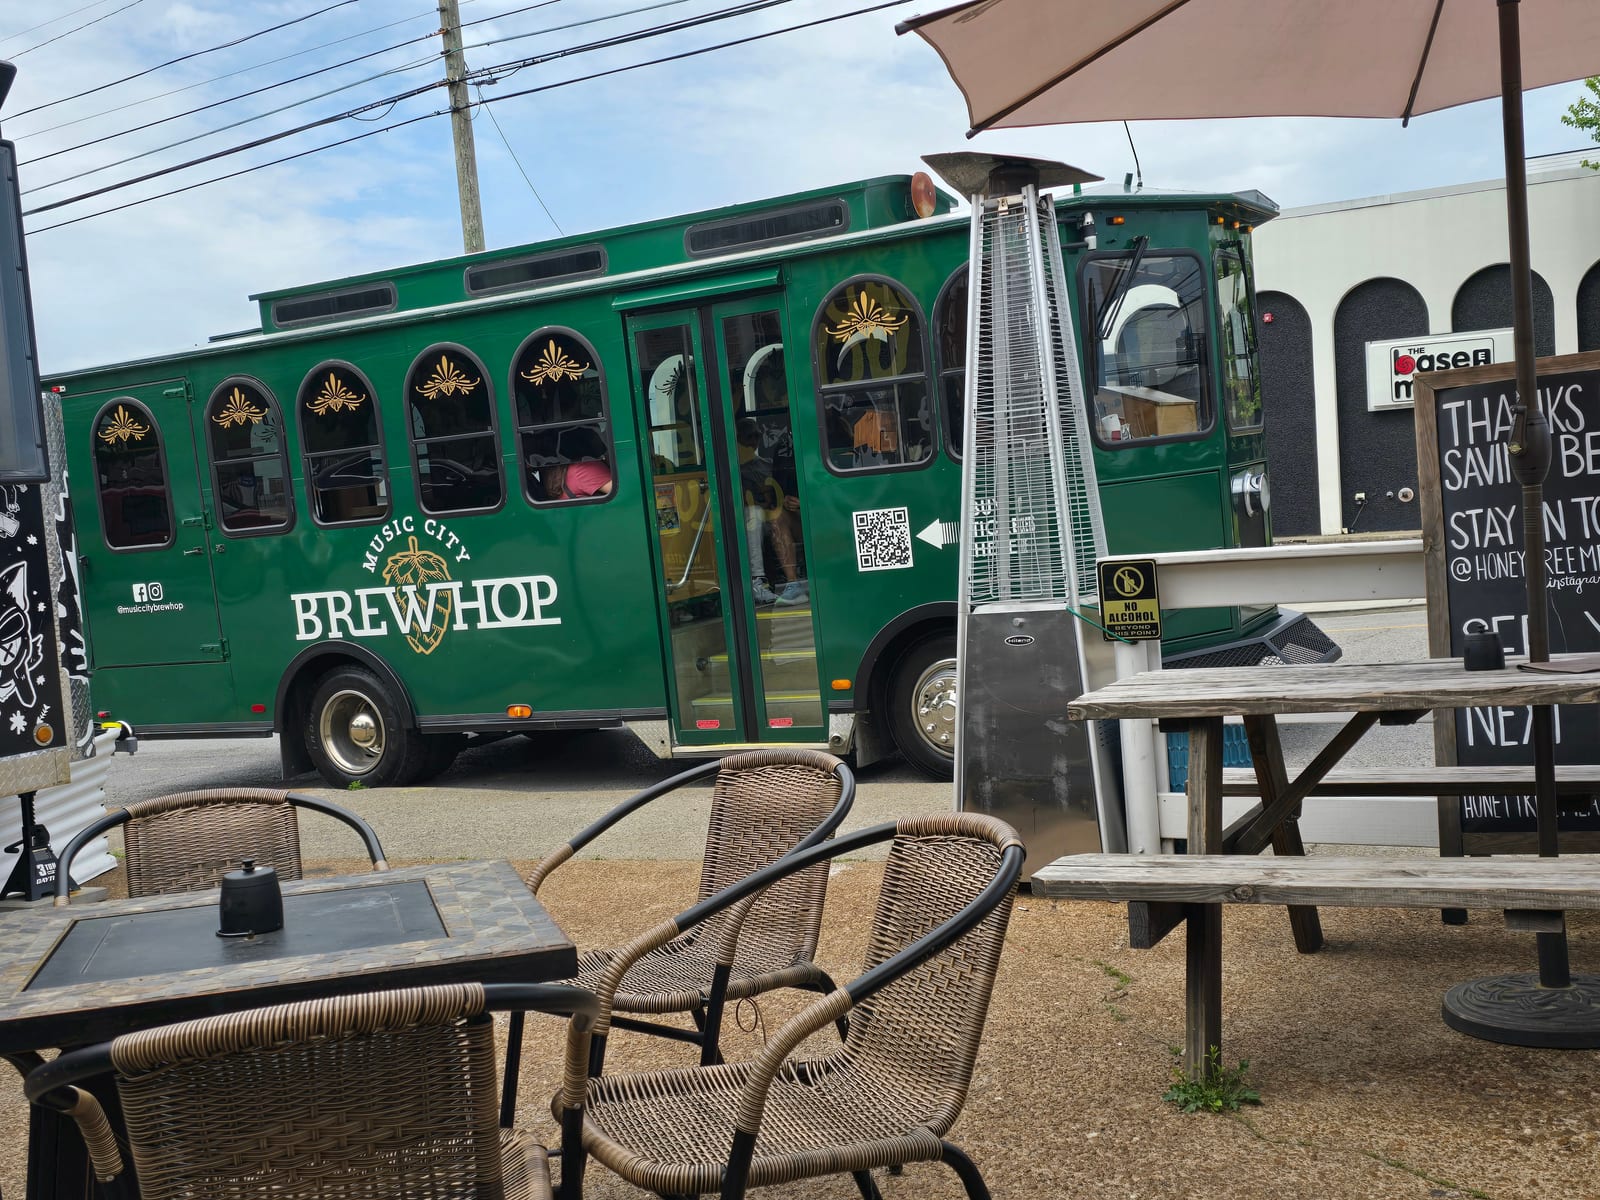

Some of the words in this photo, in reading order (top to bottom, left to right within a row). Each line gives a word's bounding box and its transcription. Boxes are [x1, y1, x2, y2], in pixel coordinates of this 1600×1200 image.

[1442, 384, 1585, 446] THAKS
[1450, 505, 1516, 550] STAY
[1542, 500, 1567, 543] N
[363, 516, 414, 573] MUSIC
[424, 519, 470, 563] CITY
[1546, 574, 1600, 594] instagra
[1109, 611, 1155, 622] ALCOHOL
[1124, 602, 1137, 612] NO
[36, 864, 46, 876] 3
